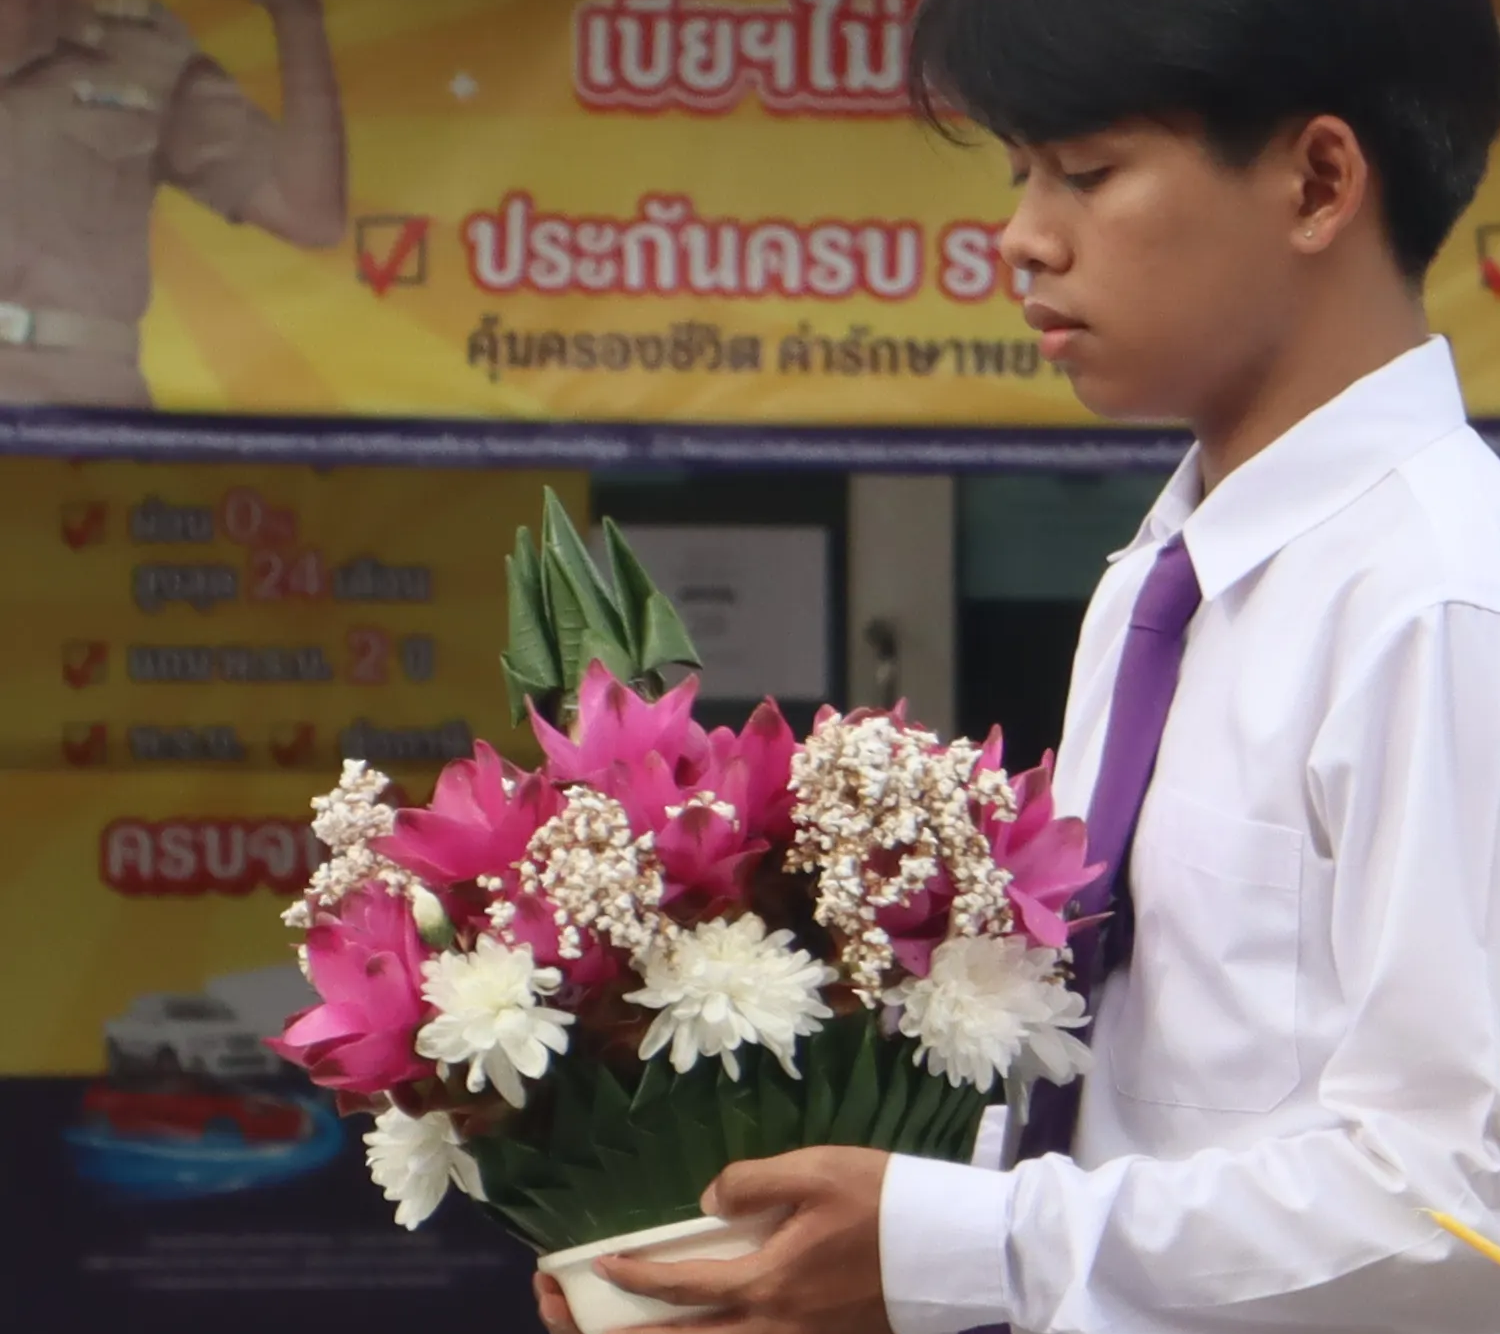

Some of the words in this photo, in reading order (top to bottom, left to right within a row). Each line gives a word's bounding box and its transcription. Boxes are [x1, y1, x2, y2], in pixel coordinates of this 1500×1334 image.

[467, 202, 919, 296] ประกันครบ
[466, 319, 763, 381] คุ้มครองชีวิต
